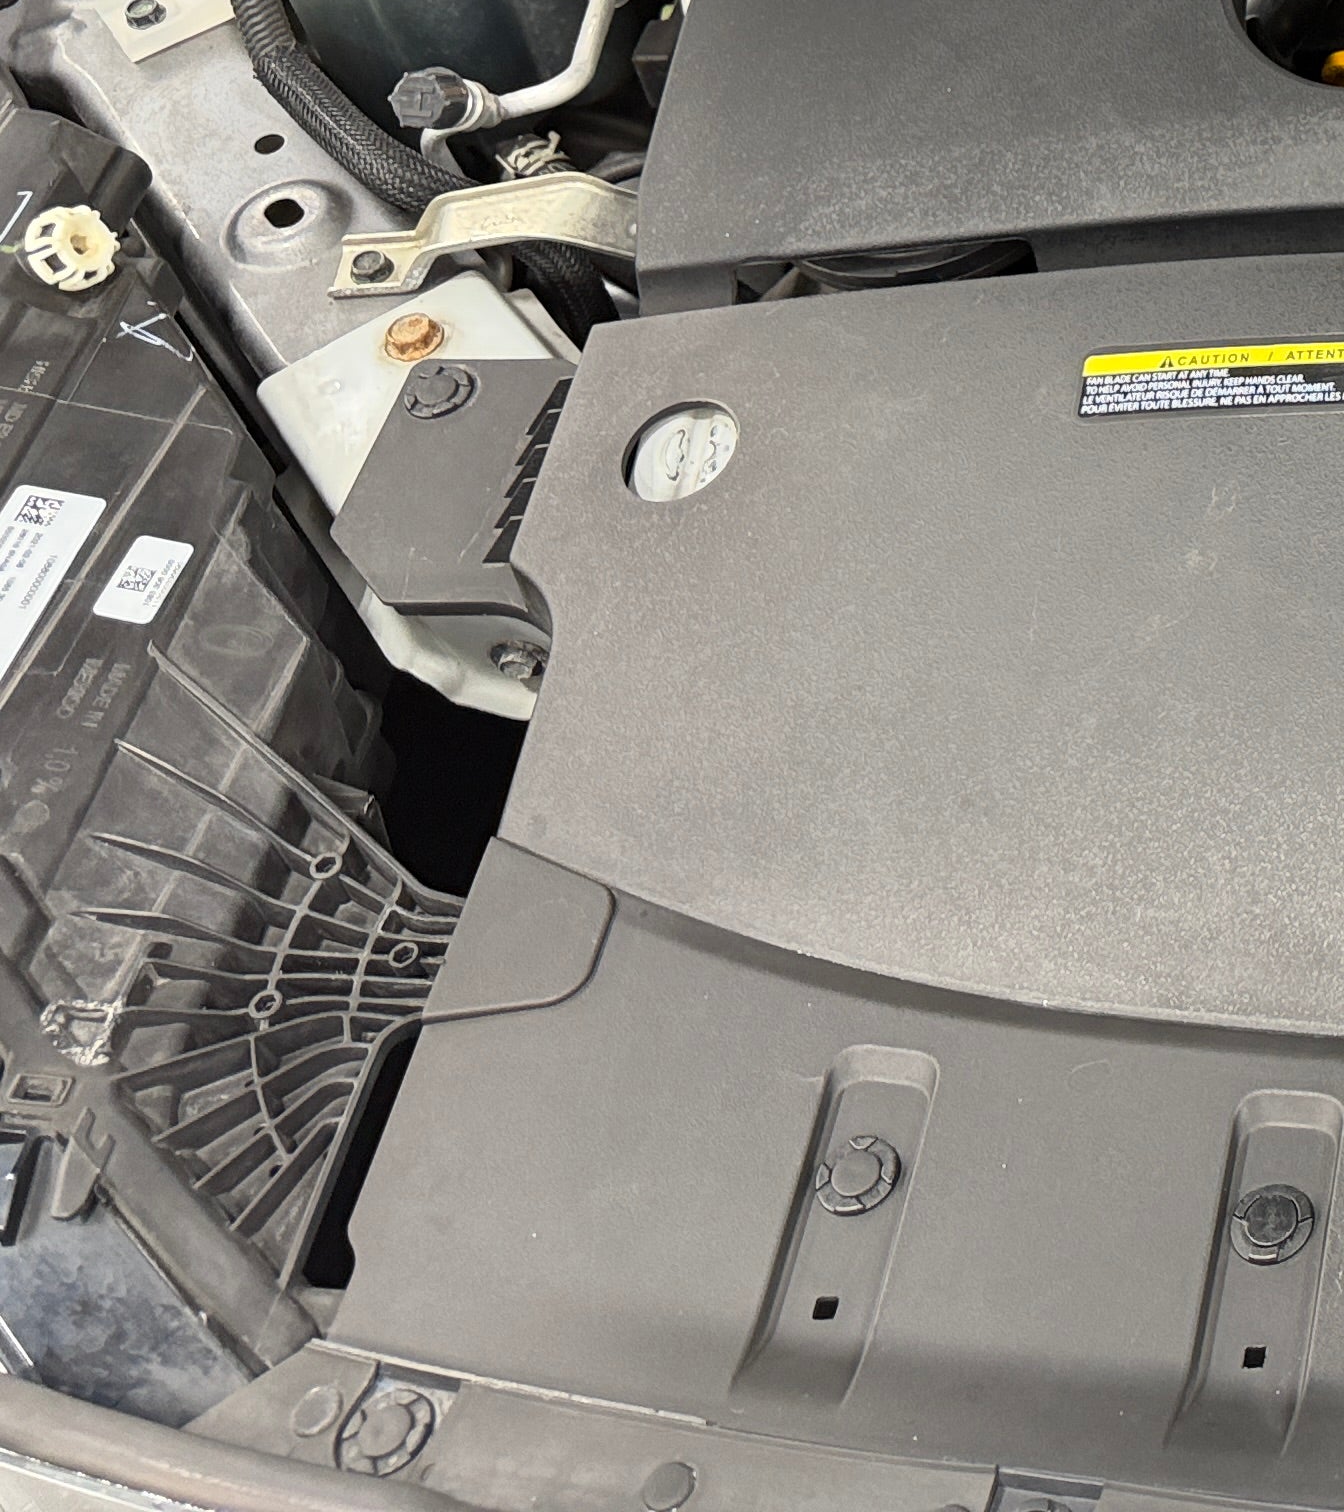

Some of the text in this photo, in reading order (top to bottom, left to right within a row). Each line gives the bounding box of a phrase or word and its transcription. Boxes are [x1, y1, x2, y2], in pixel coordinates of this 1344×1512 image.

[1177, 353, 1250, 365] CAUTION
[1086, 376, 1103, 386] FAN
[1104, 374, 1131, 384] BLADE
[1132, 373, 1151, 382] CAN
[1152, 371, 1177, 381] START
[1177, 370, 1189, 380] AT
[1189, 370, 1208, 379] ANY
[1086, 385, 1098, 395] TO
[1099, 384, 1120, 394] HELP
[1120, 382, 1147, 393] AVOID
[1148, 379, 1191, 391] PERSONAL
[1223, 376, 1245, 387] KEEP
[1245, 375, 1276, 385] HANDS
[1080, 404, 1107, 414] POUR
[1141, 399, 1170, 410] TOUTE
[1219, 396, 1233, 405] NE
[1234, 395, 1252, 405] PAS
[1252, 395, 1267, 404] EN
[1267, 392, 1323, 403] APPROCHER
[1324, 391, 1341, 401] LES
[1082, 395, 1094, 404] LE
[1095, 391, 1155, 403] VENTILATEUR
[1156, 389, 1189, 400] RISQUE
[1190, 388, 1204, 398] DE
[1265, 384, 1290, 393] TOUT
[81, 663, 132, 729] MADE IN
